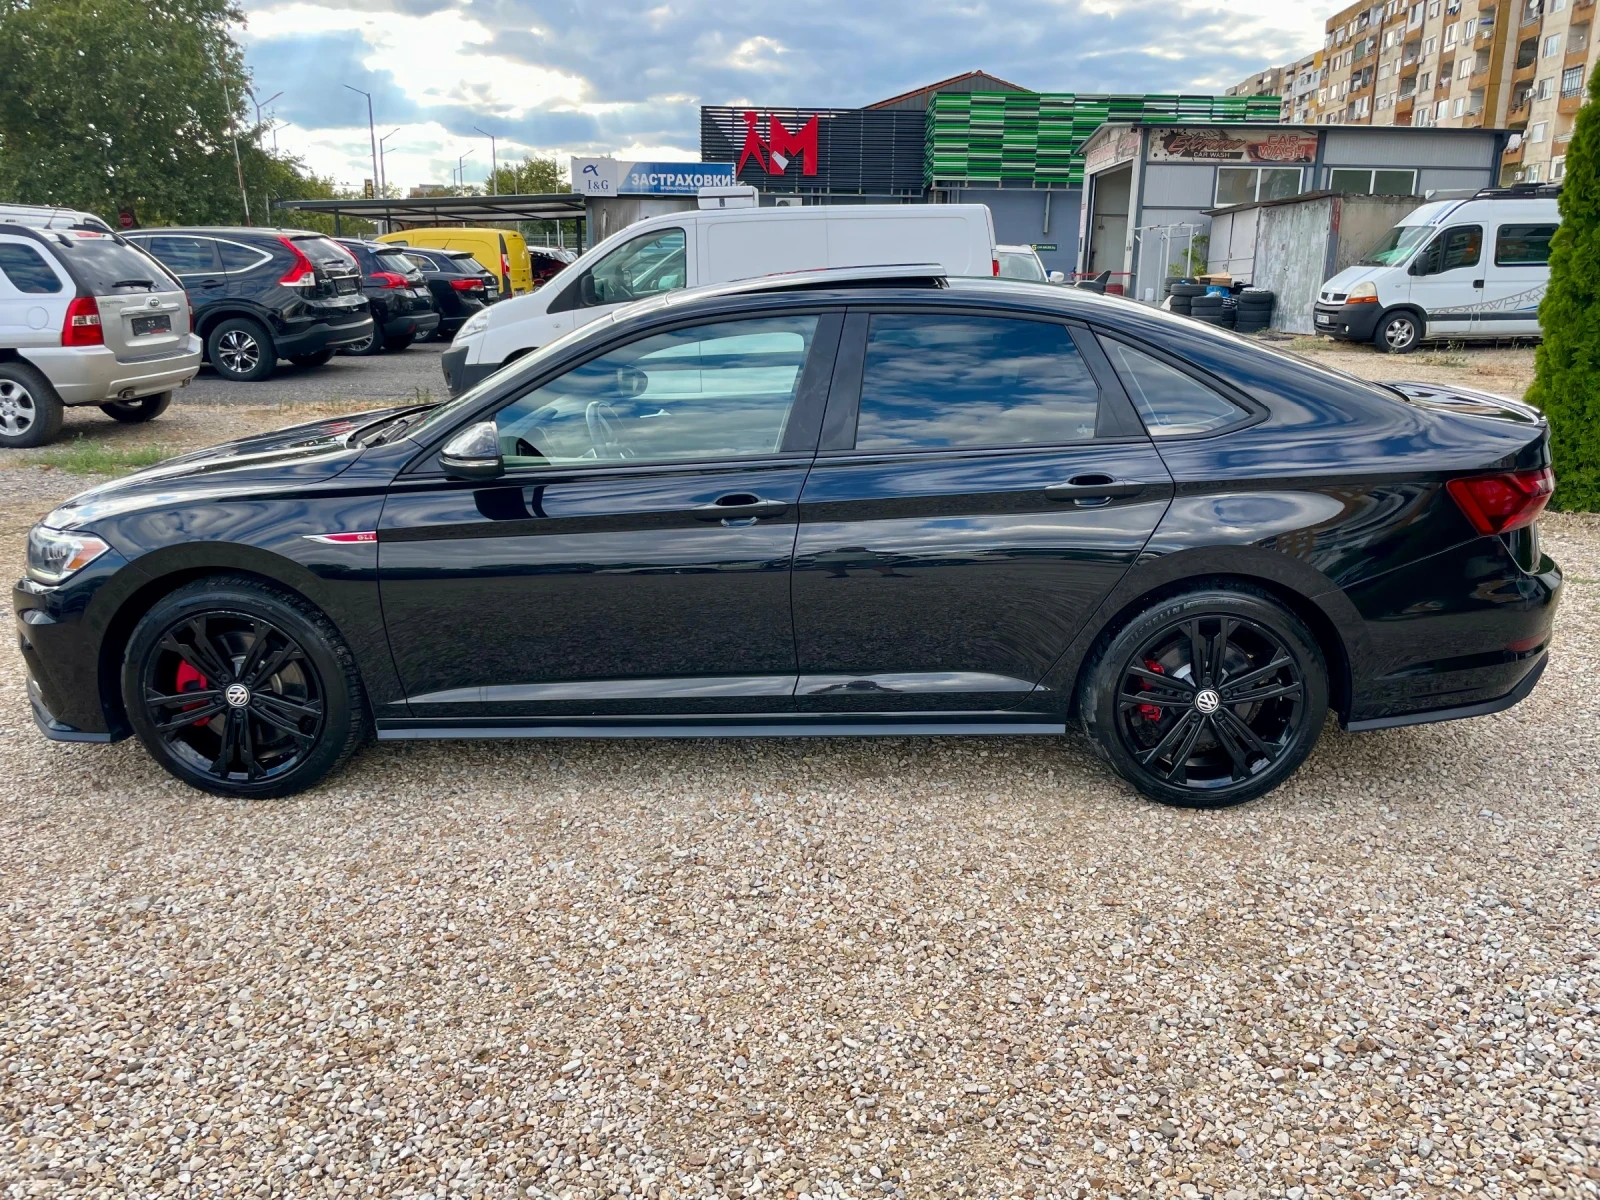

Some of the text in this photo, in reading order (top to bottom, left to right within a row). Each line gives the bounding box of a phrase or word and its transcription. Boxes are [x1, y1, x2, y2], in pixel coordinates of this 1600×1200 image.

[1266, 134, 1299, 146] CAR
[1258, 145, 1305, 158] WASH
[631, 173, 731, 187] ЗАСТРАХОВКИ
